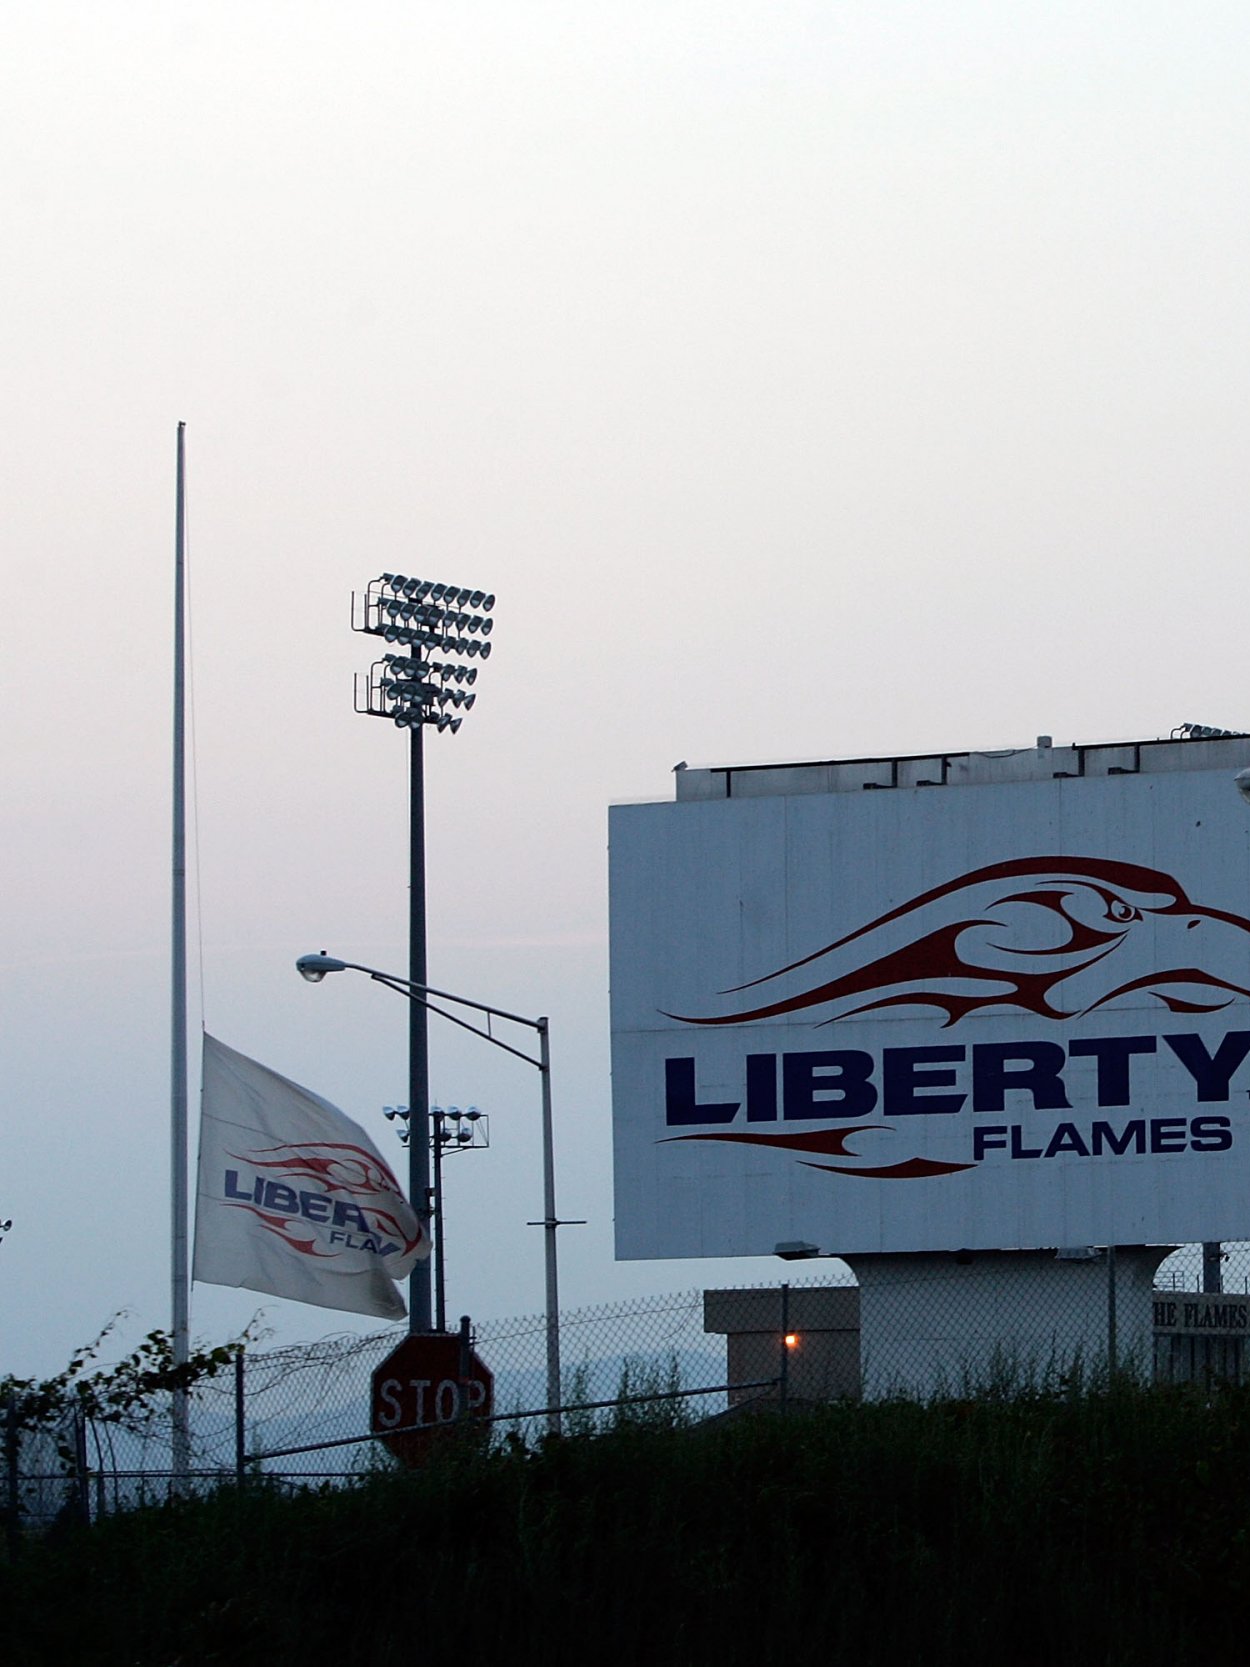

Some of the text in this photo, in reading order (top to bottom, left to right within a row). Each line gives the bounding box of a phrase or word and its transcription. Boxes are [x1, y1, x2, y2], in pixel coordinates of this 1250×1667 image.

[973, 1115, 1233, 1160] FLAMES
[224, 1169, 401, 1257] LIBER
[329, 1231, 378, 1254] FLA
[1152, 1302, 1248, 1329] HE FLAMES
[378, 1378, 486, 1427] STOP
